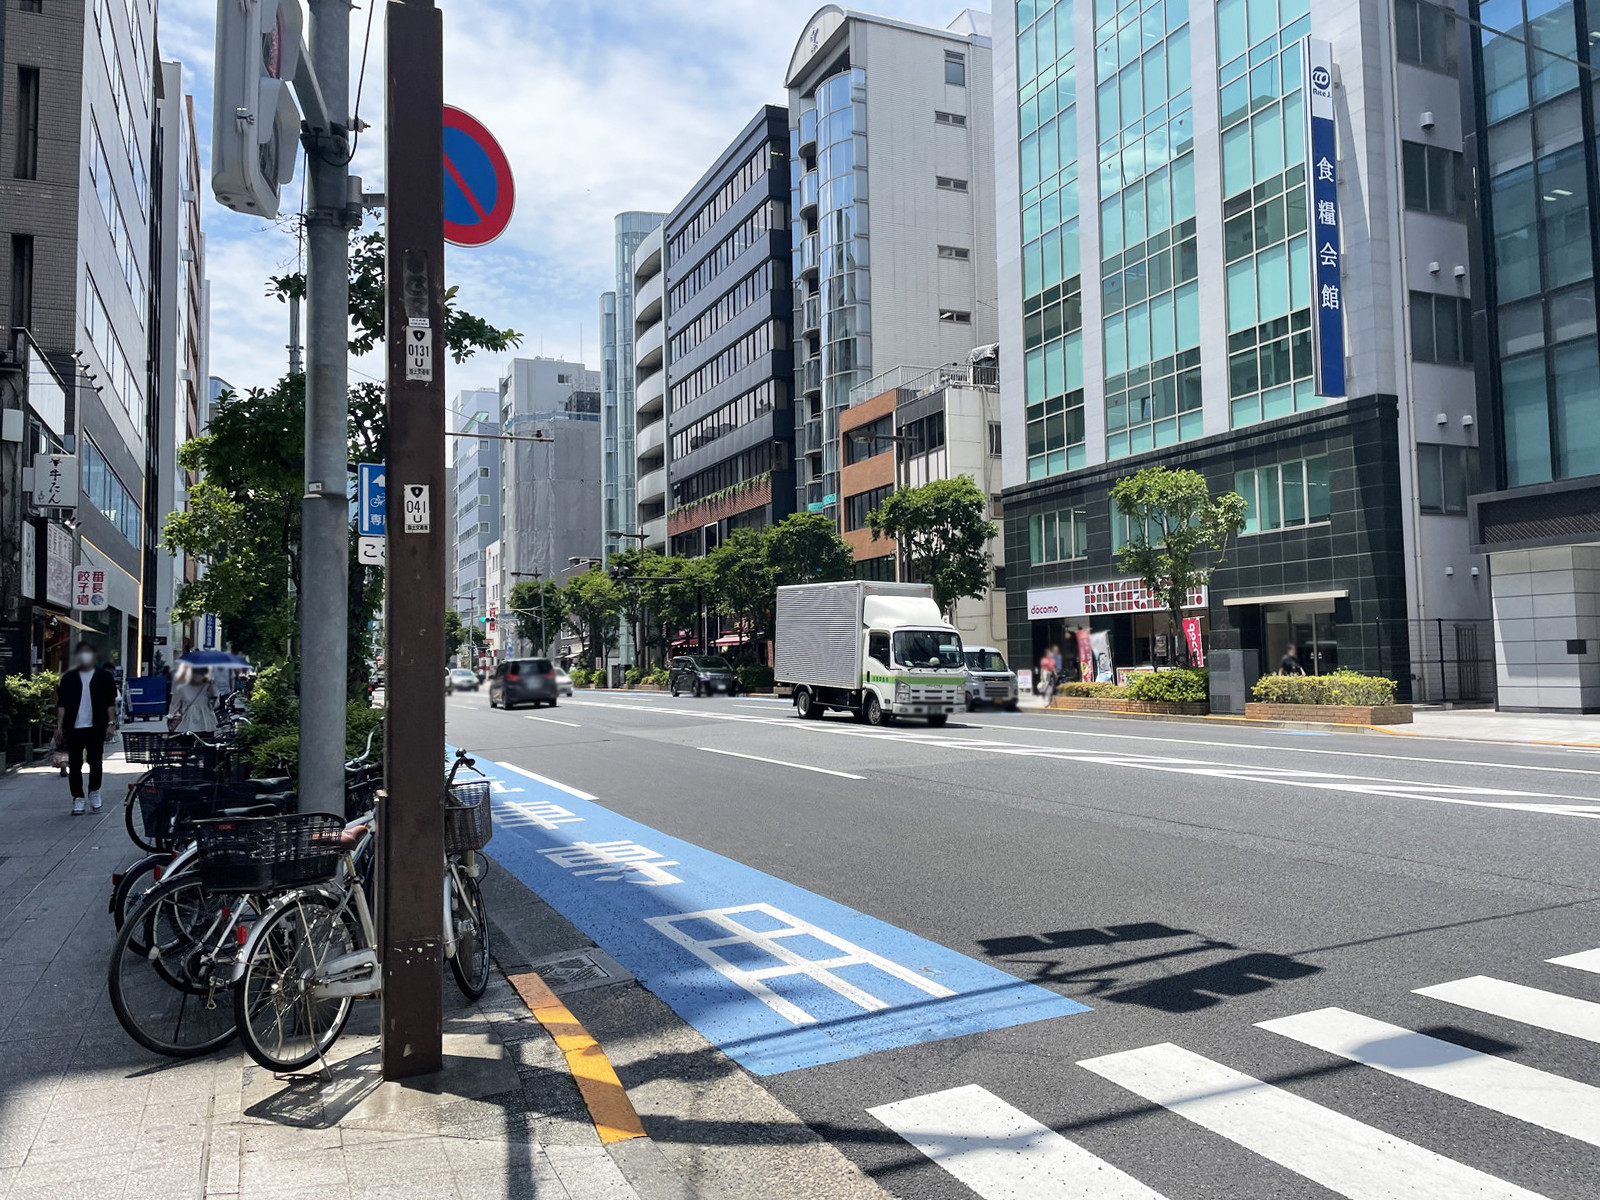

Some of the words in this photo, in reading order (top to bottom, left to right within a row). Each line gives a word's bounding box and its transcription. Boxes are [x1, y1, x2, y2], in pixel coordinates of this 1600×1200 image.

[1316, 155, 1340, 310] 食糧会館
[408, 344, 429, 357] 0131
[415, 358, 423, 367] U
[48, 468, 62, 505] 牛たん
[406, 500, 426, 514] 041
[370, 514, 386, 525] 専
[413, 514, 422, 523] U
[1031, 605, 1059, 615] docomo
